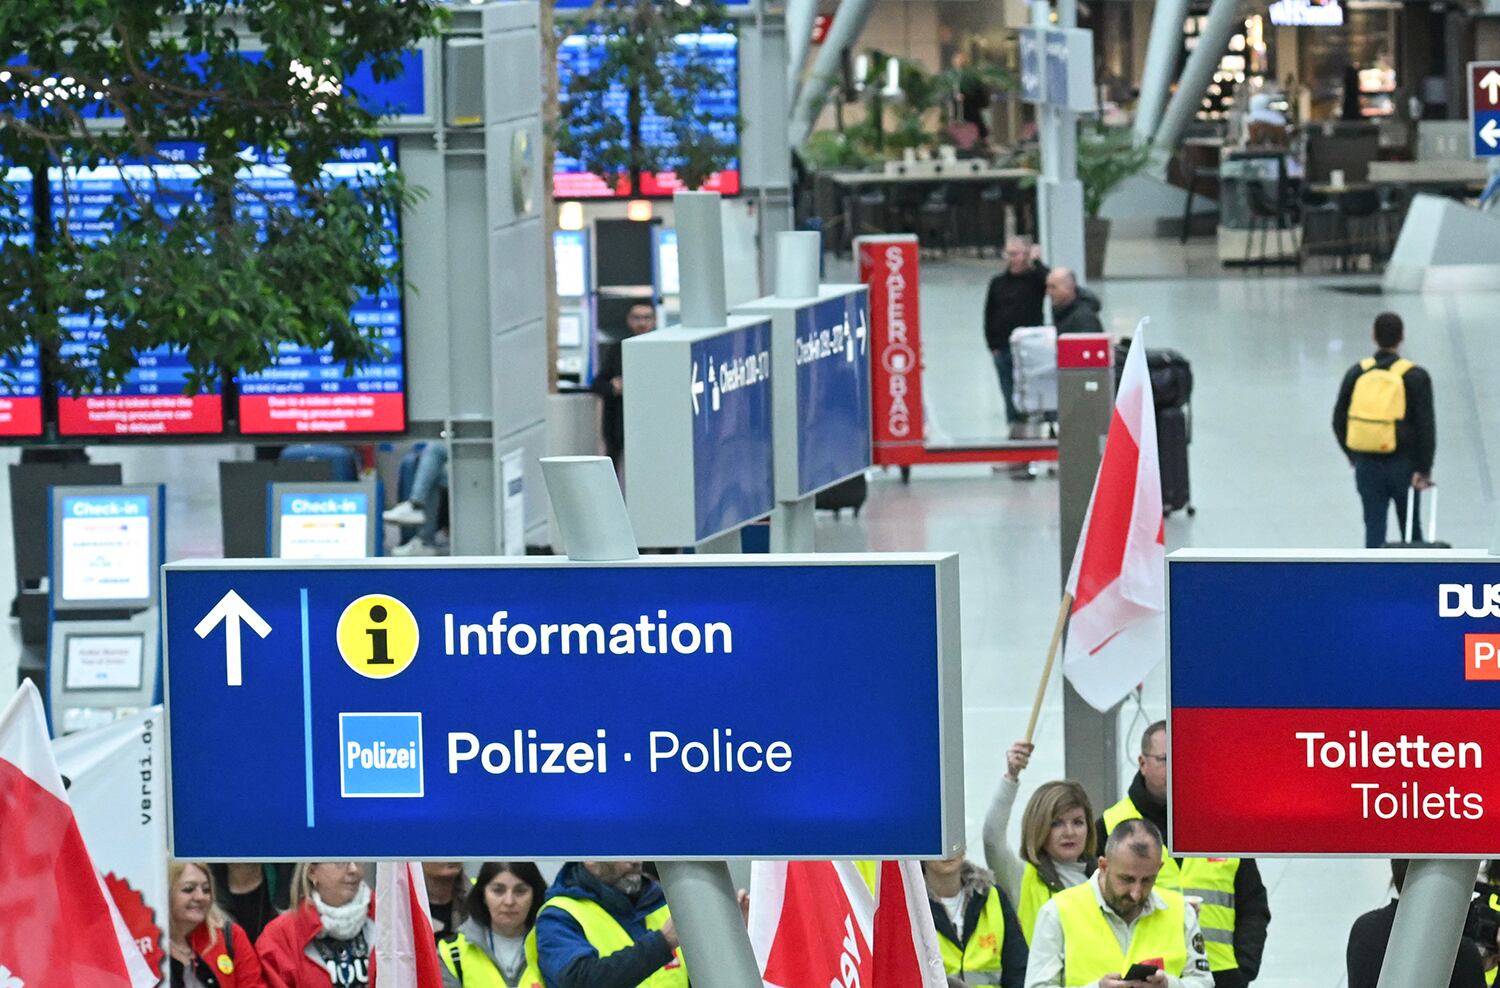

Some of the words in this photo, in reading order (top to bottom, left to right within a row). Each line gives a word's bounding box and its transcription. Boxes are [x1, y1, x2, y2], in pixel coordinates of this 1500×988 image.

[73, 501, 138, 516] Check-in
[291, 498, 356, 513] Check-in
[444, 610, 732, 656] Information
[348, 742, 416, 769] Polizei
[448, 730, 607, 774] Polizei
[649, 729, 792, 773] Police
[1296, 731, 1482, 769] Toiletten
[1351, 782, 1484, 820] Toilets
